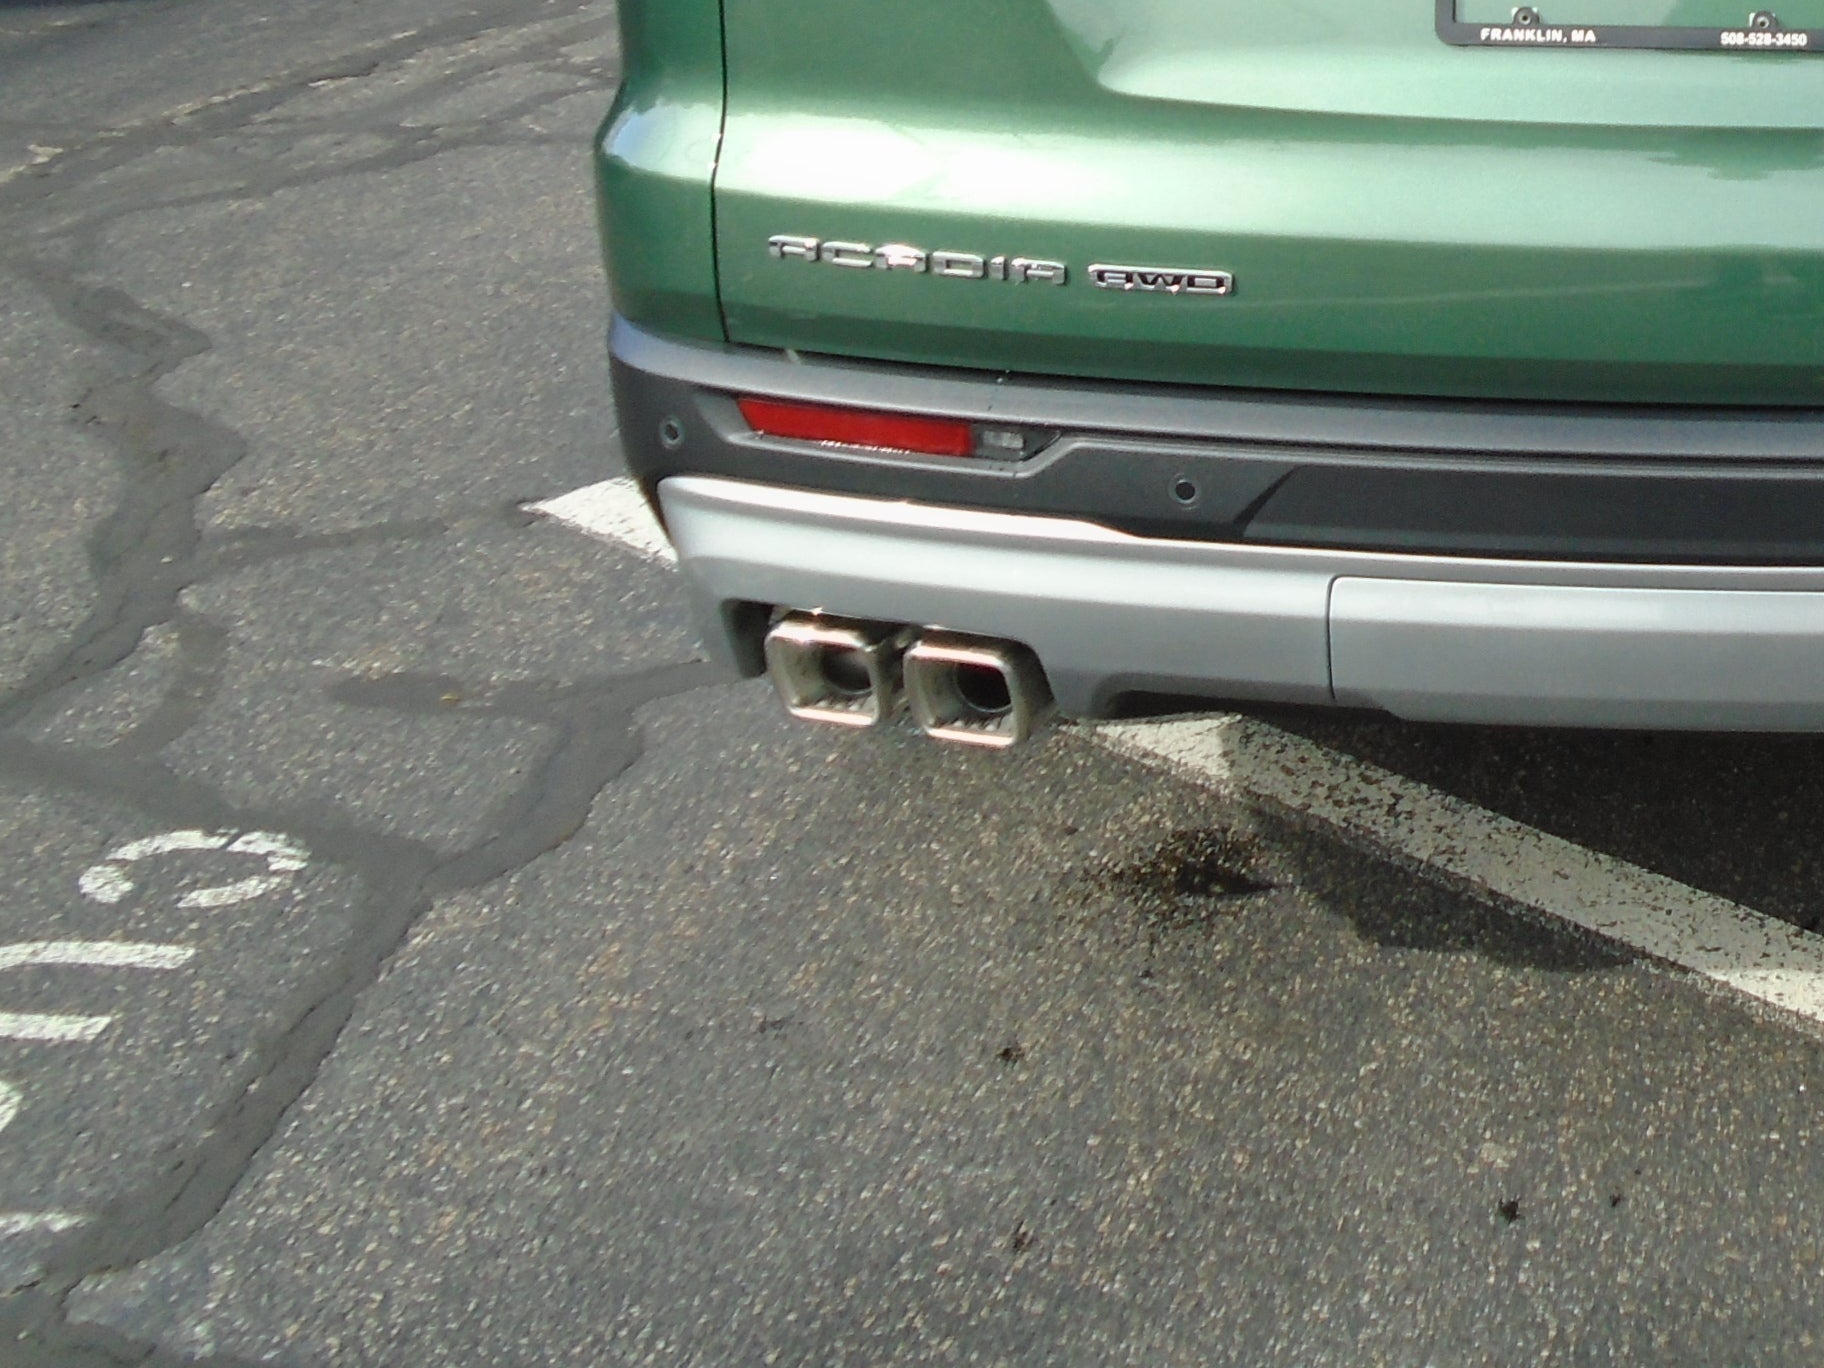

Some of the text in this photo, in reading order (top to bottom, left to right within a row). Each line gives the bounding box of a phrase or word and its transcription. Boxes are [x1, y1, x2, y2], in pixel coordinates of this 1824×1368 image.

[1480, 27, 1596, 44] FRANKLIN, MA
[1720, 32, 1808, 47] 508-528-3450
[768, 234, 1067, 286] ACADIA
